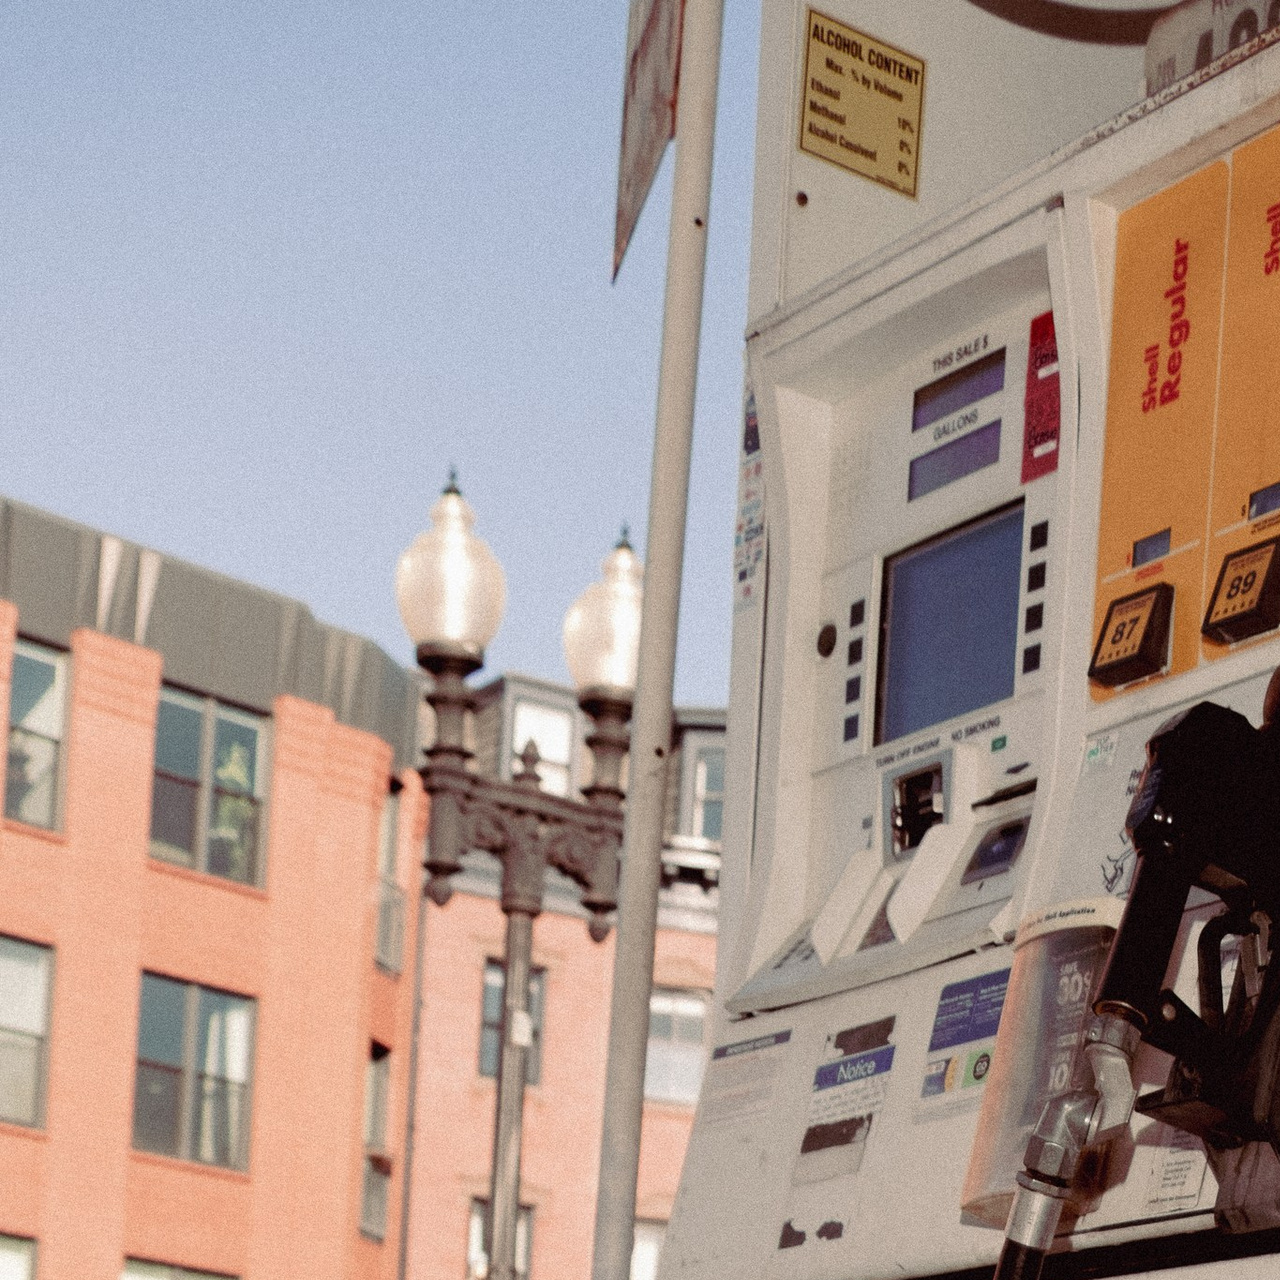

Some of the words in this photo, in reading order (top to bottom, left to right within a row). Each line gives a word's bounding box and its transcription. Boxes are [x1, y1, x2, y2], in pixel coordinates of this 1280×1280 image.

[812, 24, 864, 62] ALCOHOL
[868, 48, 921, 86] CONTENT
[1160, 238, 1190, 406] Regular
[932, 353, 954, 373] THIS
[955, 340, 979, 362] SALE
[1142, 343, 1160, 414] Shell
[932, 408, 979, 441] GALLONS
[1226, 570, 1257, 600] 89
[1111, 616, 1140, 645] 87
[951, 728, 963, 742] NO
[964, 714, 1001, 739] SMOKING
[837, 1059, 876, 1083] Notice
